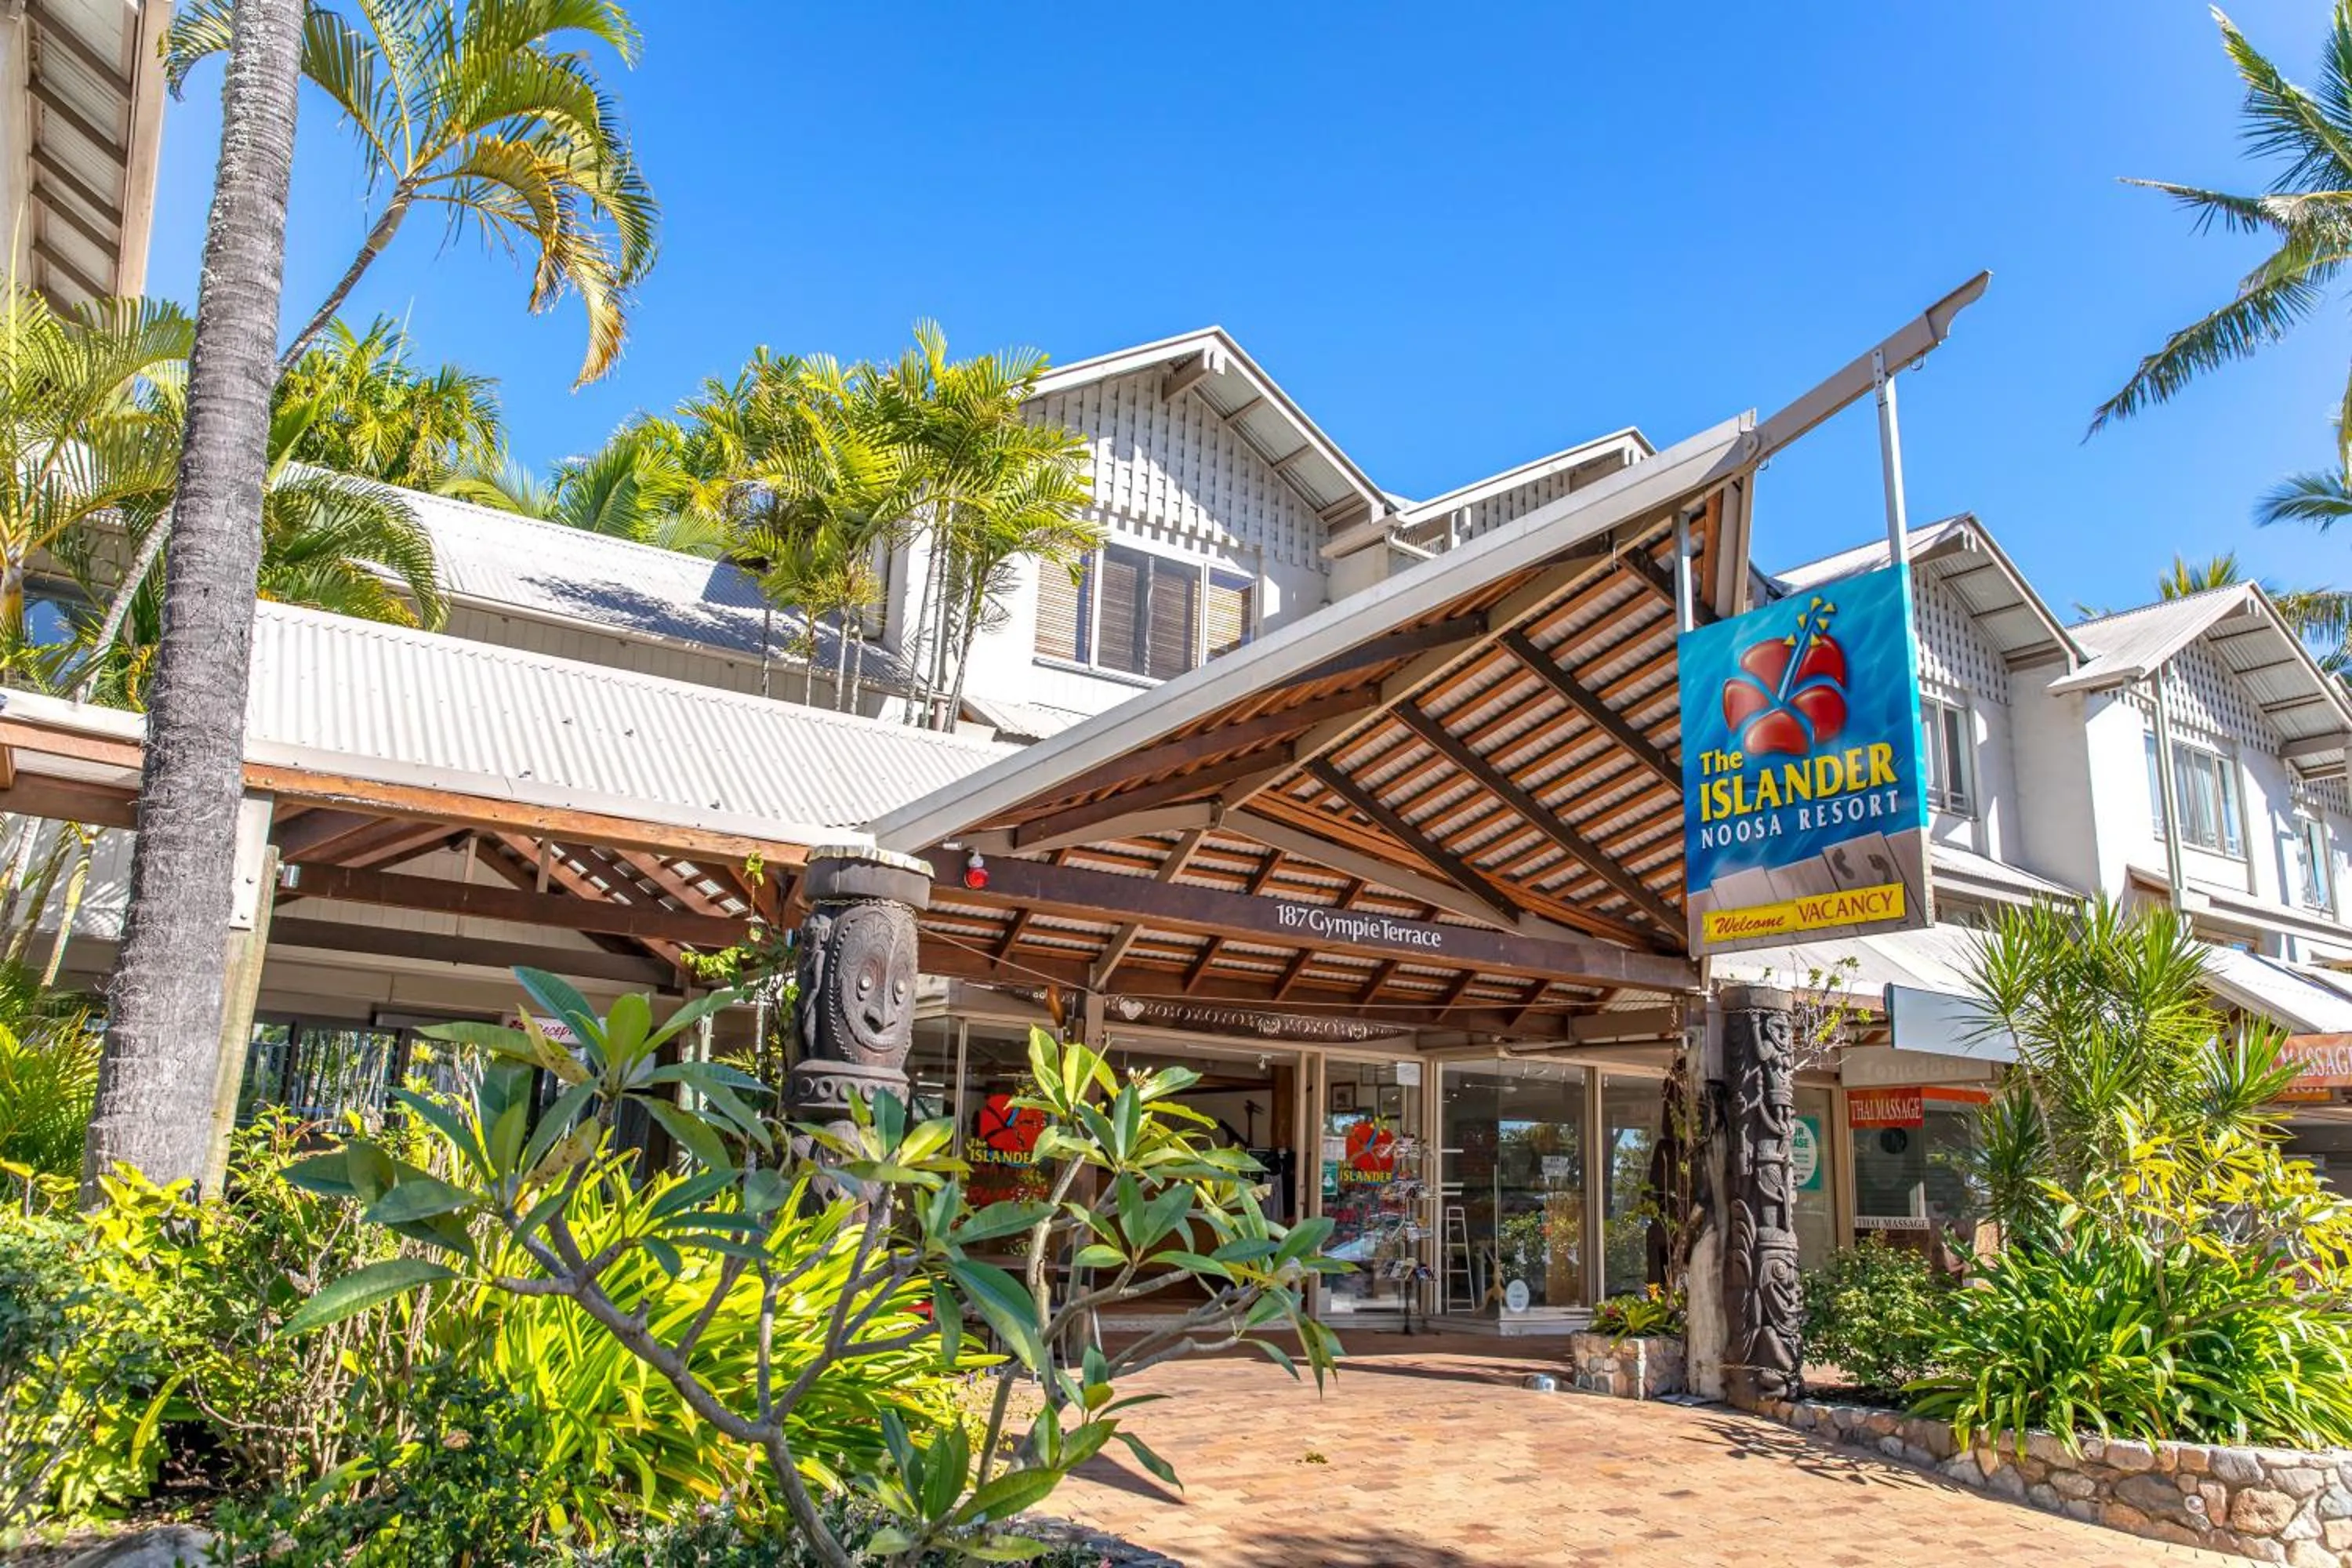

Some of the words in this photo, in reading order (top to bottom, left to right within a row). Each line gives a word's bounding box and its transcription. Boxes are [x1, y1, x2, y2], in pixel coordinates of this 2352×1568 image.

[1700, 749, 1744, 776] The
[1700, 742, 1898, 822] ISLANDER
[1701, 814, 1782, 849] NOOSA
[1798, 789, 1898, 831] RESORT
[1276, 904, 1308, 927] 187
[1308, 909, 1380, 941] Gympie
[1380, 920, 1442, 948] Terrace
[1715, 915, 1785, 935] Welcome
[1797, 891, 1894, 924] VACANCY
[1849, 1099, 1875, 1121] THAI
[1875, 1097, 1922, 1121] MASSAGE
[969, 1138, 987, 1149] The
[970, 1149, 1033, 1164] ISLANDE
[1857, 1218, 1880, 1229] THAI
[1884, 1219, 1926, 1229] MASSAGE
